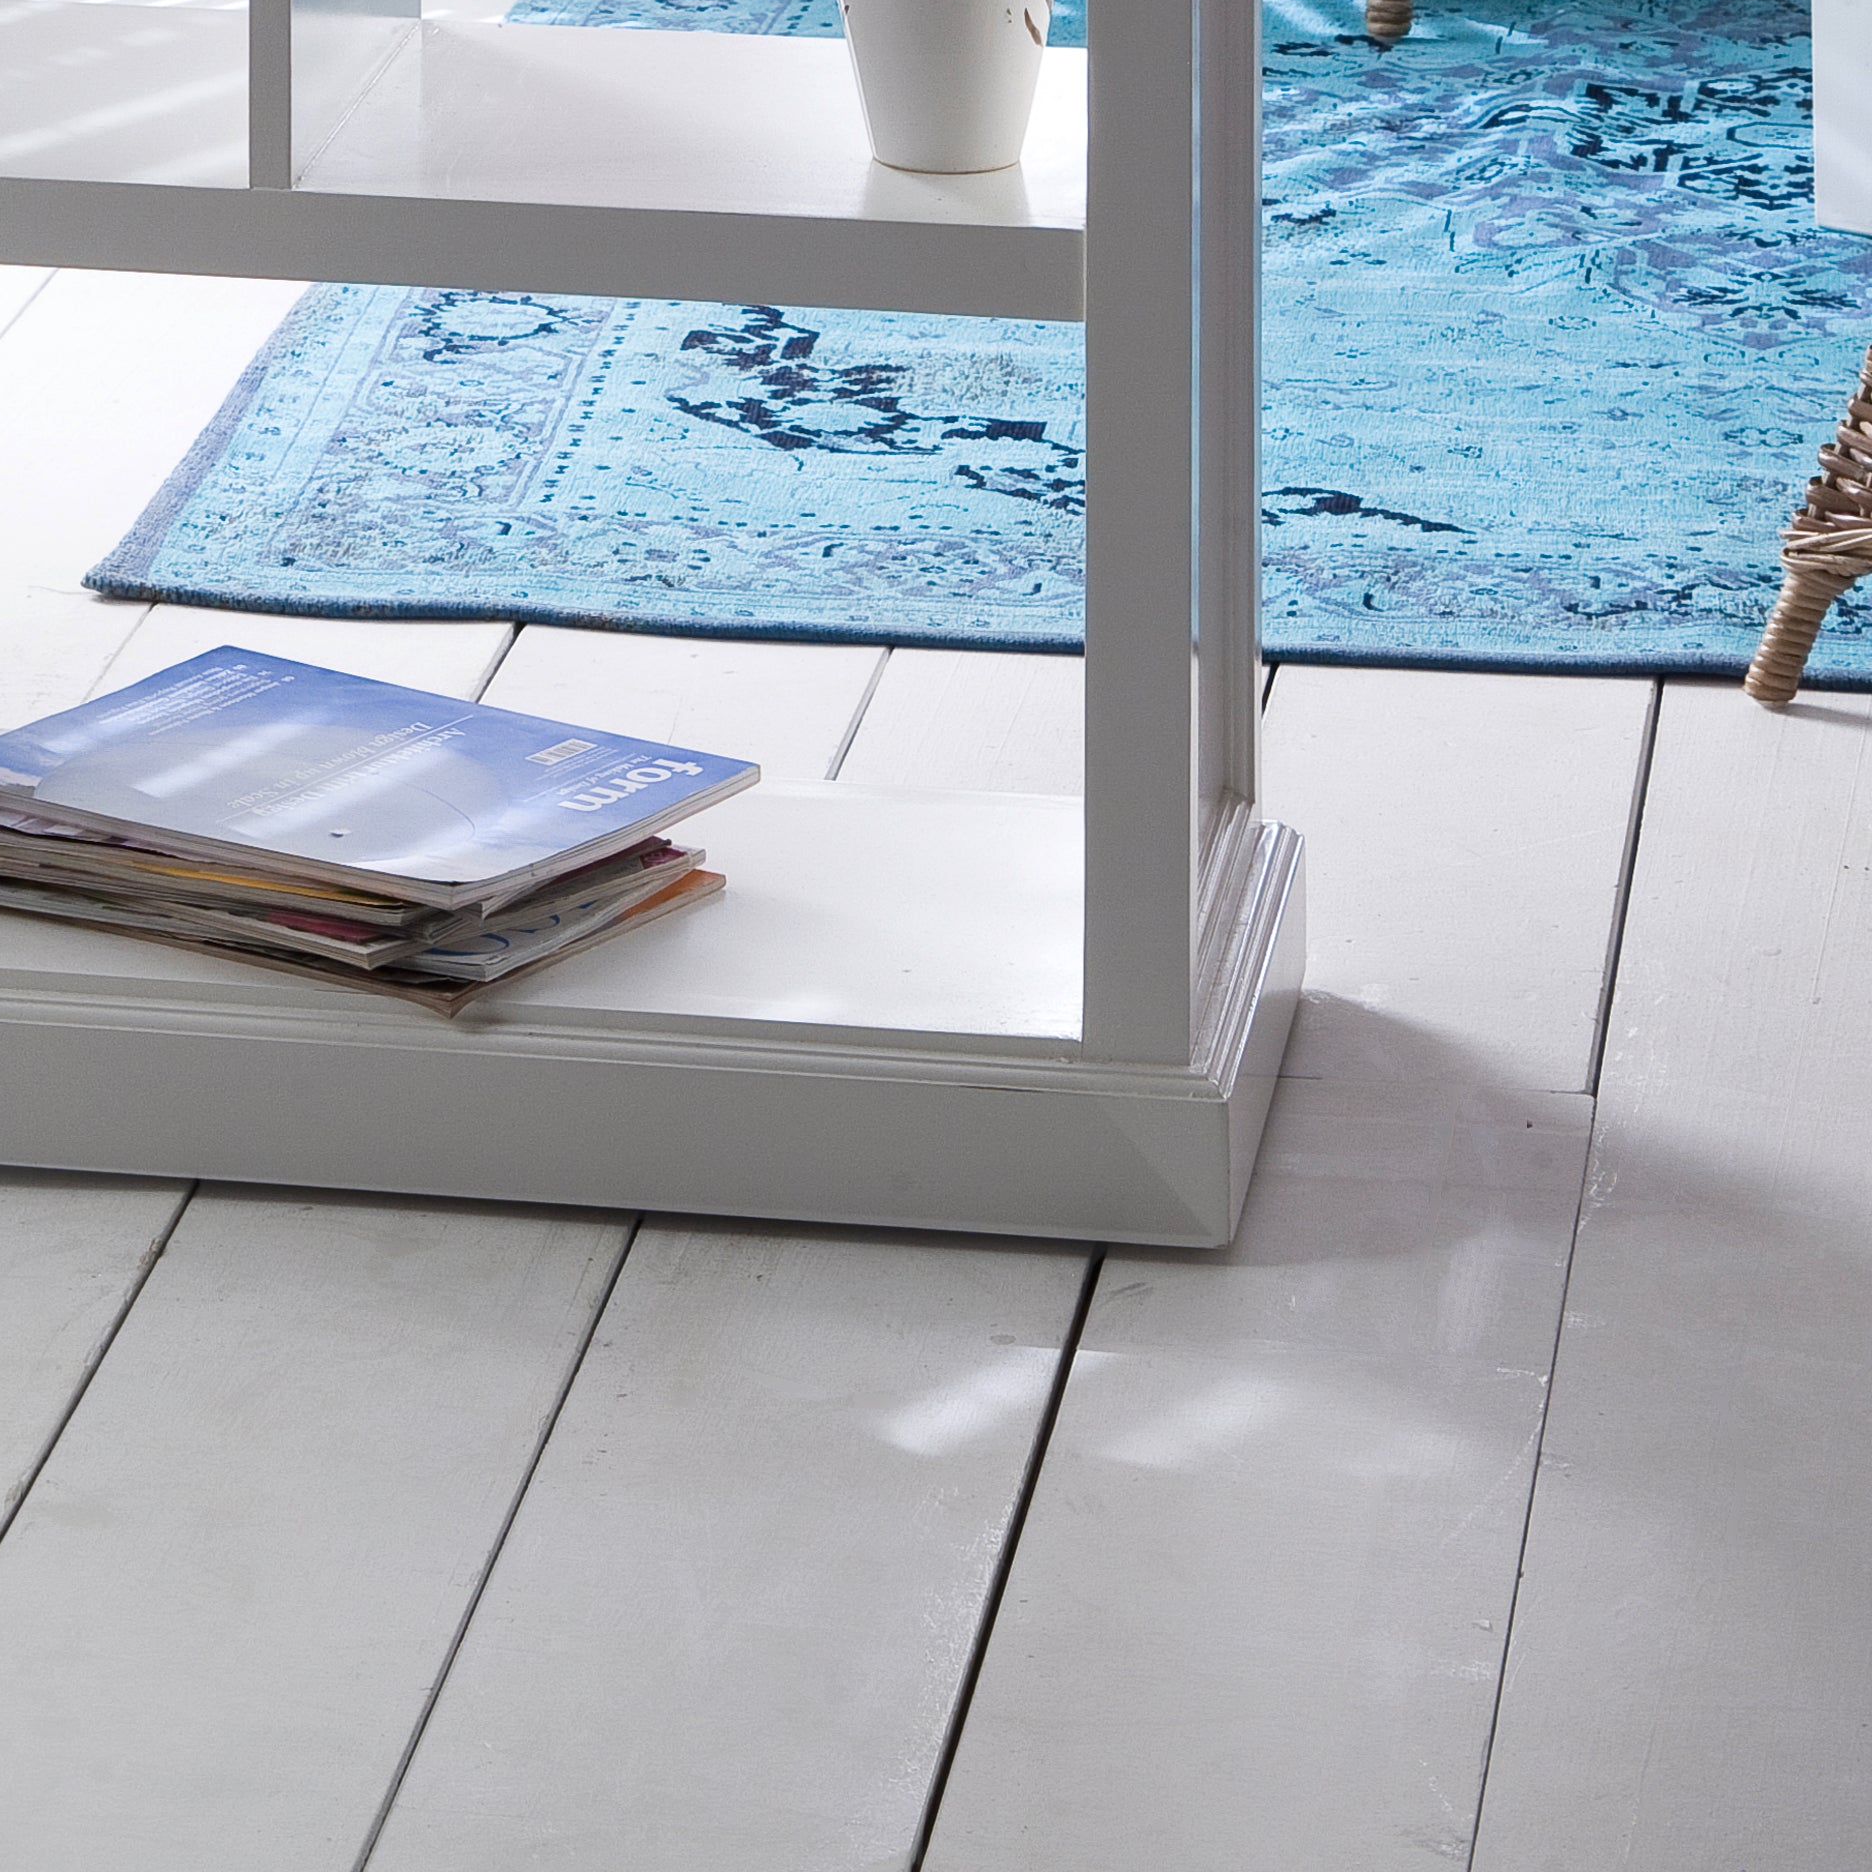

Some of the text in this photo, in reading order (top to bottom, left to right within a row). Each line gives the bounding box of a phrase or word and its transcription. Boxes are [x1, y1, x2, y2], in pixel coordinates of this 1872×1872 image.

[224, 721, 432, 809] Design blown up in Scale
[359, 727, 468, 772] Architektur
[253, 791, 326, 817] Design
[559, 758, 705, 811] form
